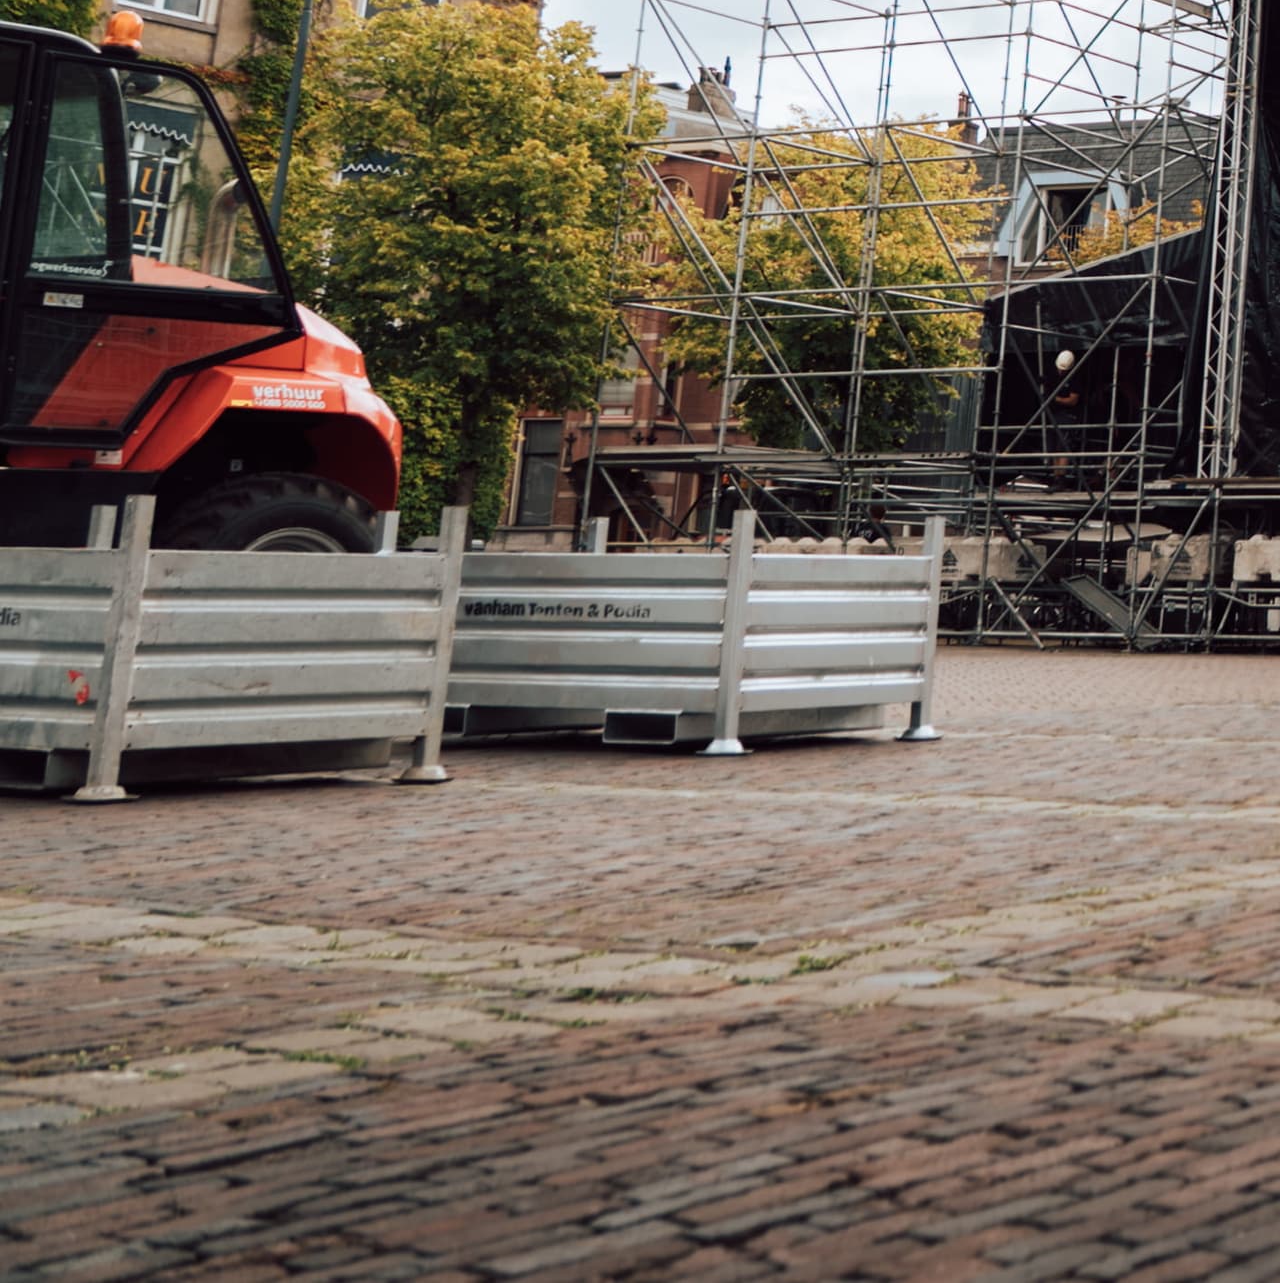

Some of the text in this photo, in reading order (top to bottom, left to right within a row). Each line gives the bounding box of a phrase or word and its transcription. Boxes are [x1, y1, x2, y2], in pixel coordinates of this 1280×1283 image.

[252, 384, 325, 401] verhuur
[465, 600, 525, 617] vanham
[588, 603, 599, 618] &
